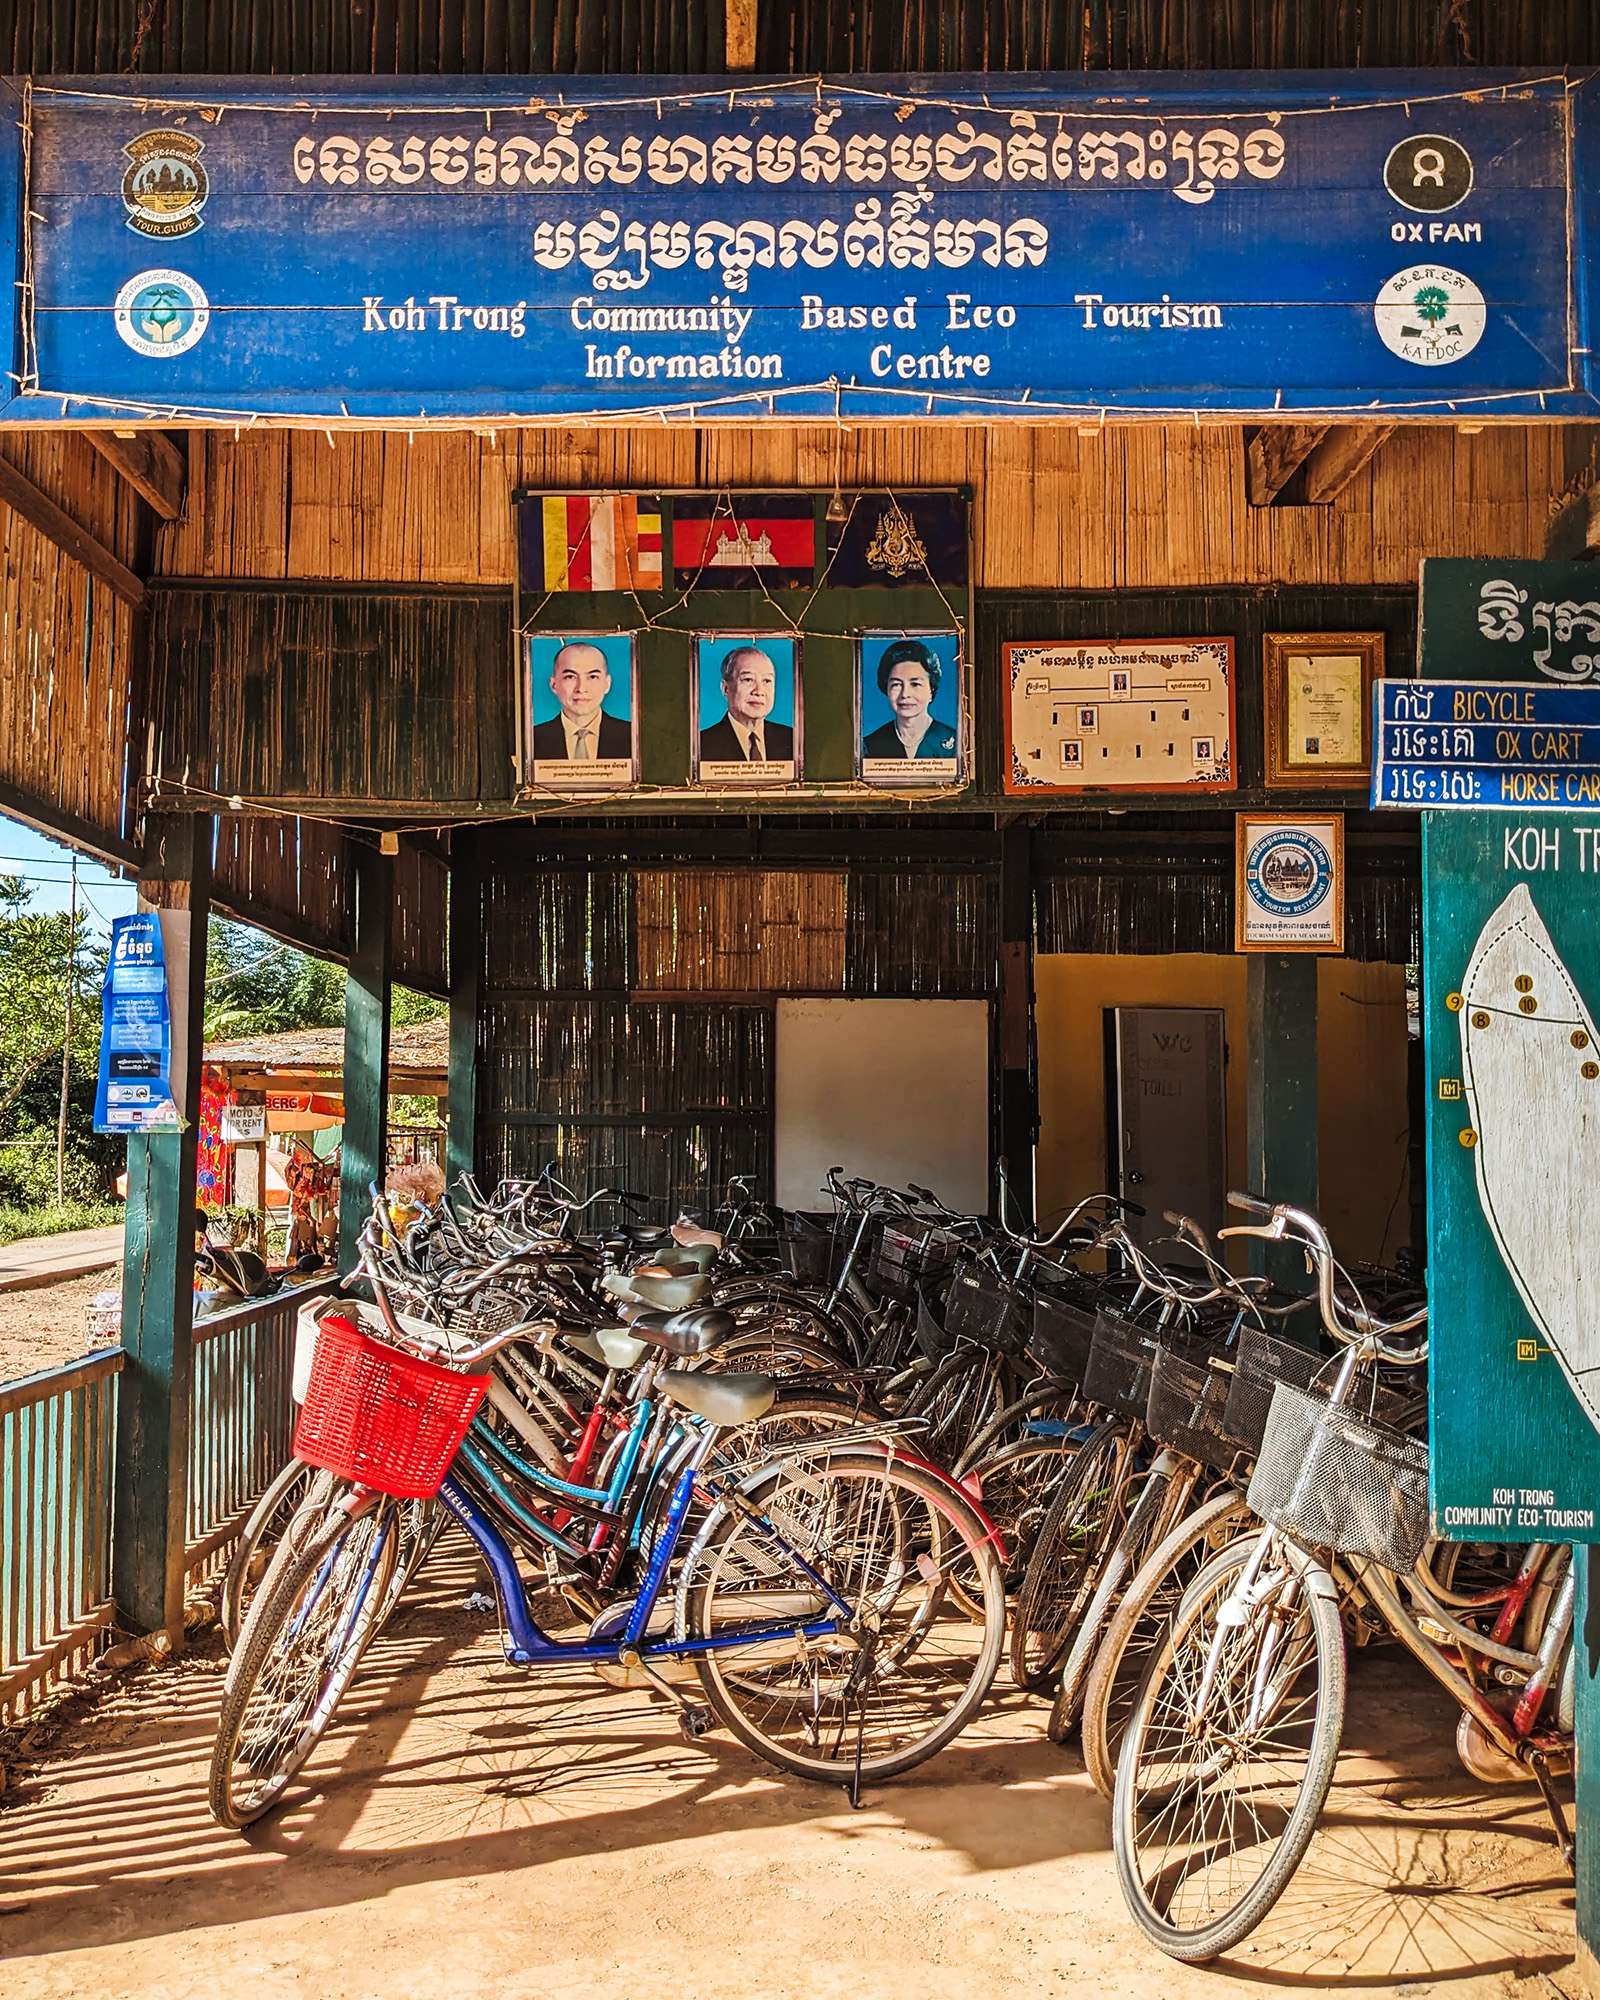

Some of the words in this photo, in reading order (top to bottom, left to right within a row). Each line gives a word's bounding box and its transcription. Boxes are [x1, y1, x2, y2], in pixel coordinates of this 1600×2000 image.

[362, 297, 424, 331] Koh
[429, 297, 527, 338] Trong
[571, 296, 753, 343] Community
[800, 296, 918, 330] Based
[945, 294, 1017, 330] Eco
[1074, 294, 1223, 329] Tourism
[584, 344, 783, 379] Information
[870, 343, 991, 379] Centre
[1453, 691, 1536, 722] BICYCLE
[1496, 731, 1522, 760] OX
[1531, 732, 1583, 760] CART
[1501, 772, 1560, 801] HORSE
[1504, 827, 1559, 871] KOH
[1249, 882, 1263, 901] SAFE
[1262, 899, 1291, 913] TOURISM
[230, 1109, 253, 1118] MOTO
[242, 1119, 262, 1128] RENT
[1493, 1488, 1515, 1505] KOH
[1519, 1489, 1554, 1505] TRONG
[1444, 1506, 1513, 1526] COMMUNITY
[1517, 1510, 1593, 1528] ECO-TOURISM
